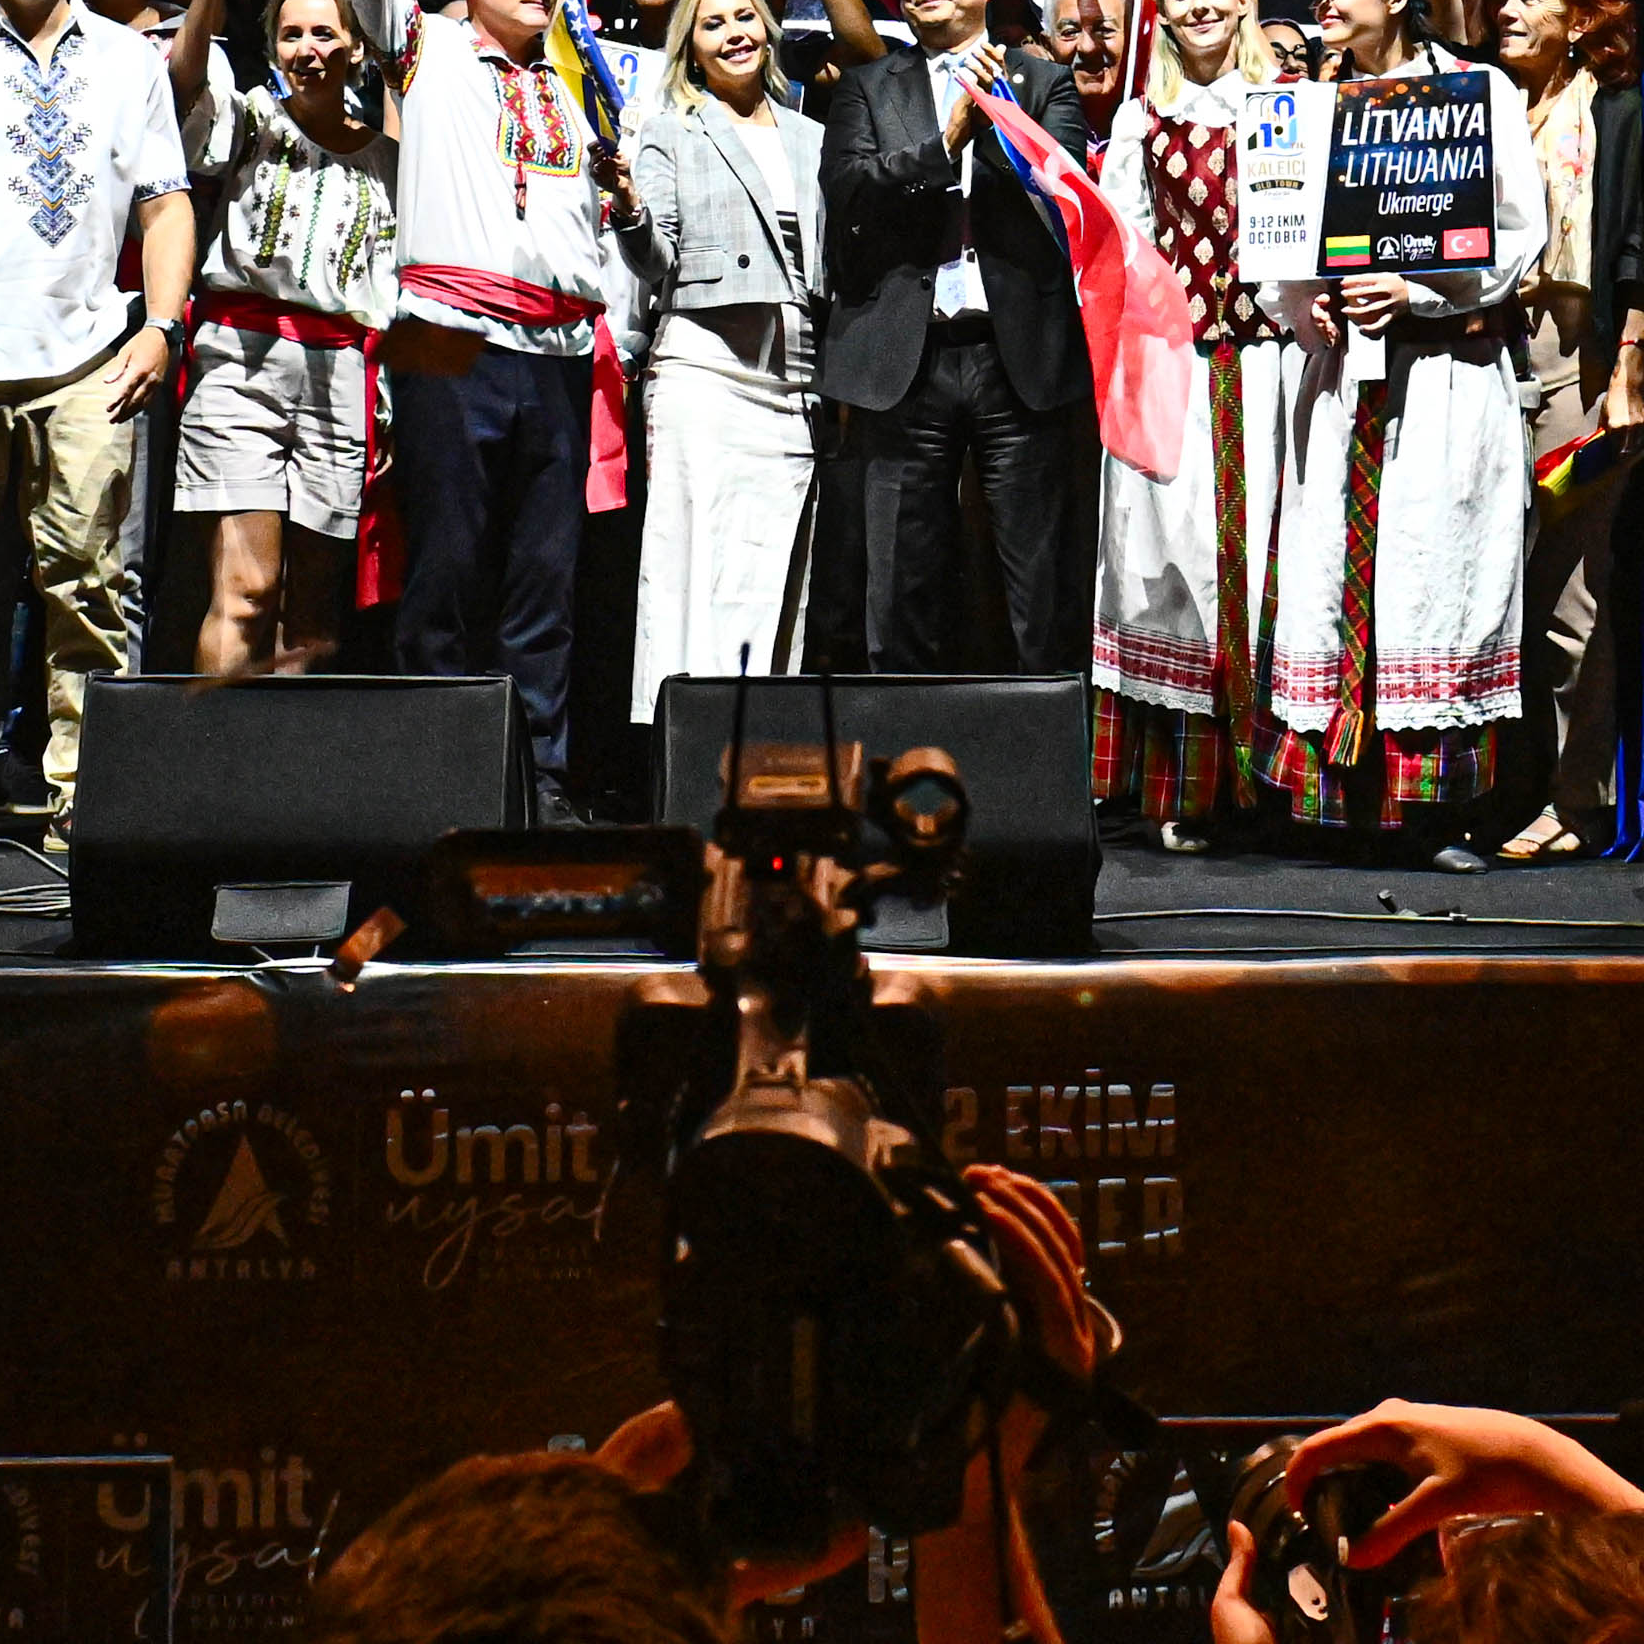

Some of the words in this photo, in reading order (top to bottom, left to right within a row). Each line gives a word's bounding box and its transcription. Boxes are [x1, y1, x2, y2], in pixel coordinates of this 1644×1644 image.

[1342, 101, 1485, 146] LİTVANYA
[1345, 145, 1485, 187] LITHUANIA
[1249, 215, 1274, 229] 9-12
[1278, 212, 1305, 228] EKİM
[1378, 192, 1454, 217] Ukmerge
[1249, 229, 1306, 245] OCTOBER
[1006, 1067, 1176, 1158] EKİM
[386, 1087, 599, 1187] Ümit
